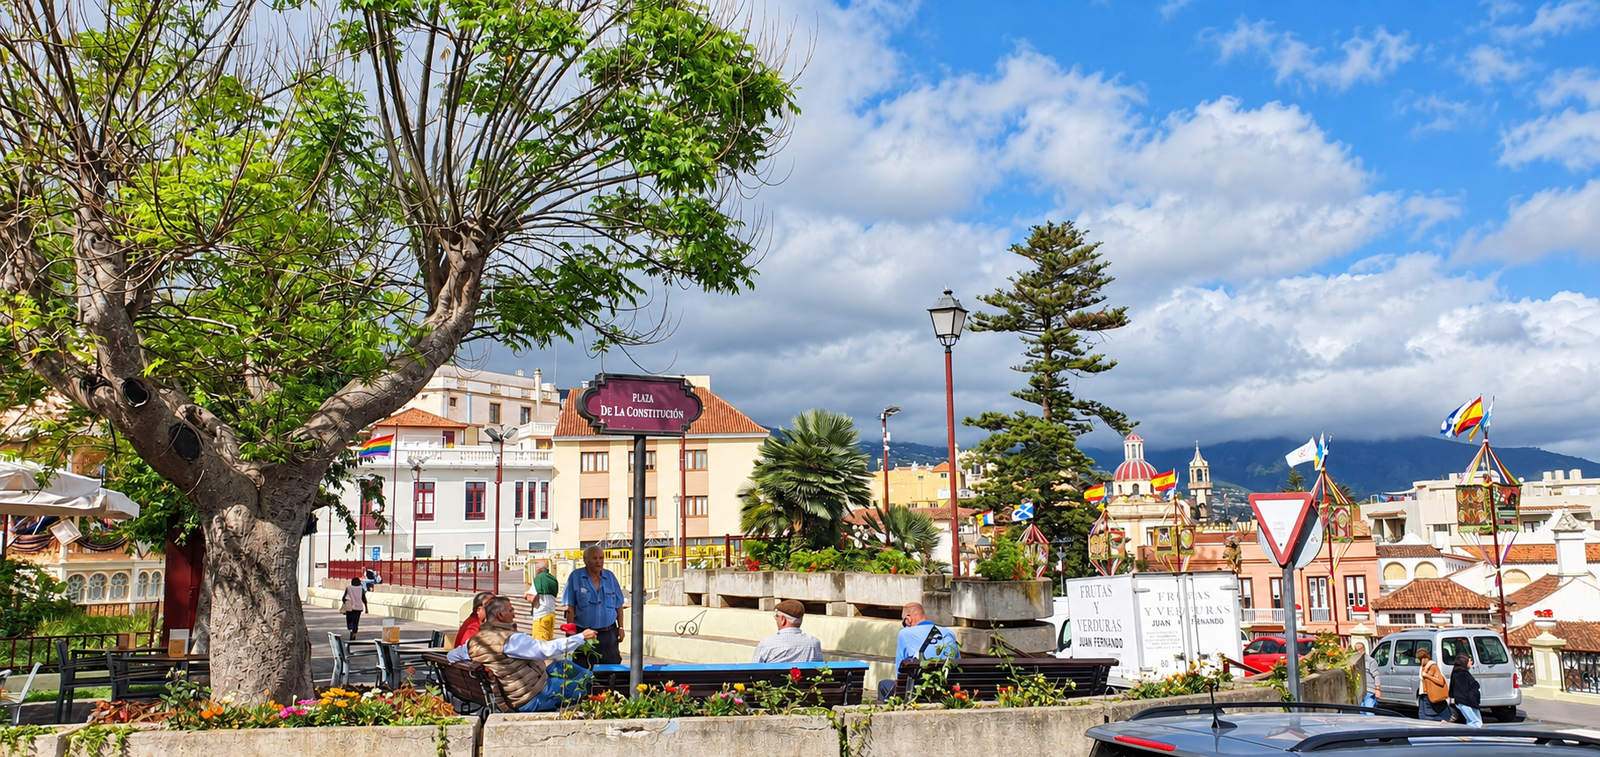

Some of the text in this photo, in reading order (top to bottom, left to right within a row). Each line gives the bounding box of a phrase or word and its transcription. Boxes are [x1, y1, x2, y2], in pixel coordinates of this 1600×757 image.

[632, 393, 654, 403] PLAZA
[600, 405, 684, 419] DE LA CONSTITUCIÓN
[1080, 584, 1113, 598] FRUTAS
[1093, 601, 1100, 614] Y
[1144, 606, 1152, 616] Y
[1077, 619, 1122, 632] VERDURAS
[1152, 618, 1224, 627] JUAN RNANDO
[1079, 637, 1124, 649] JUAN FERNANDO
[1160, 659, 1169, 668] 80
